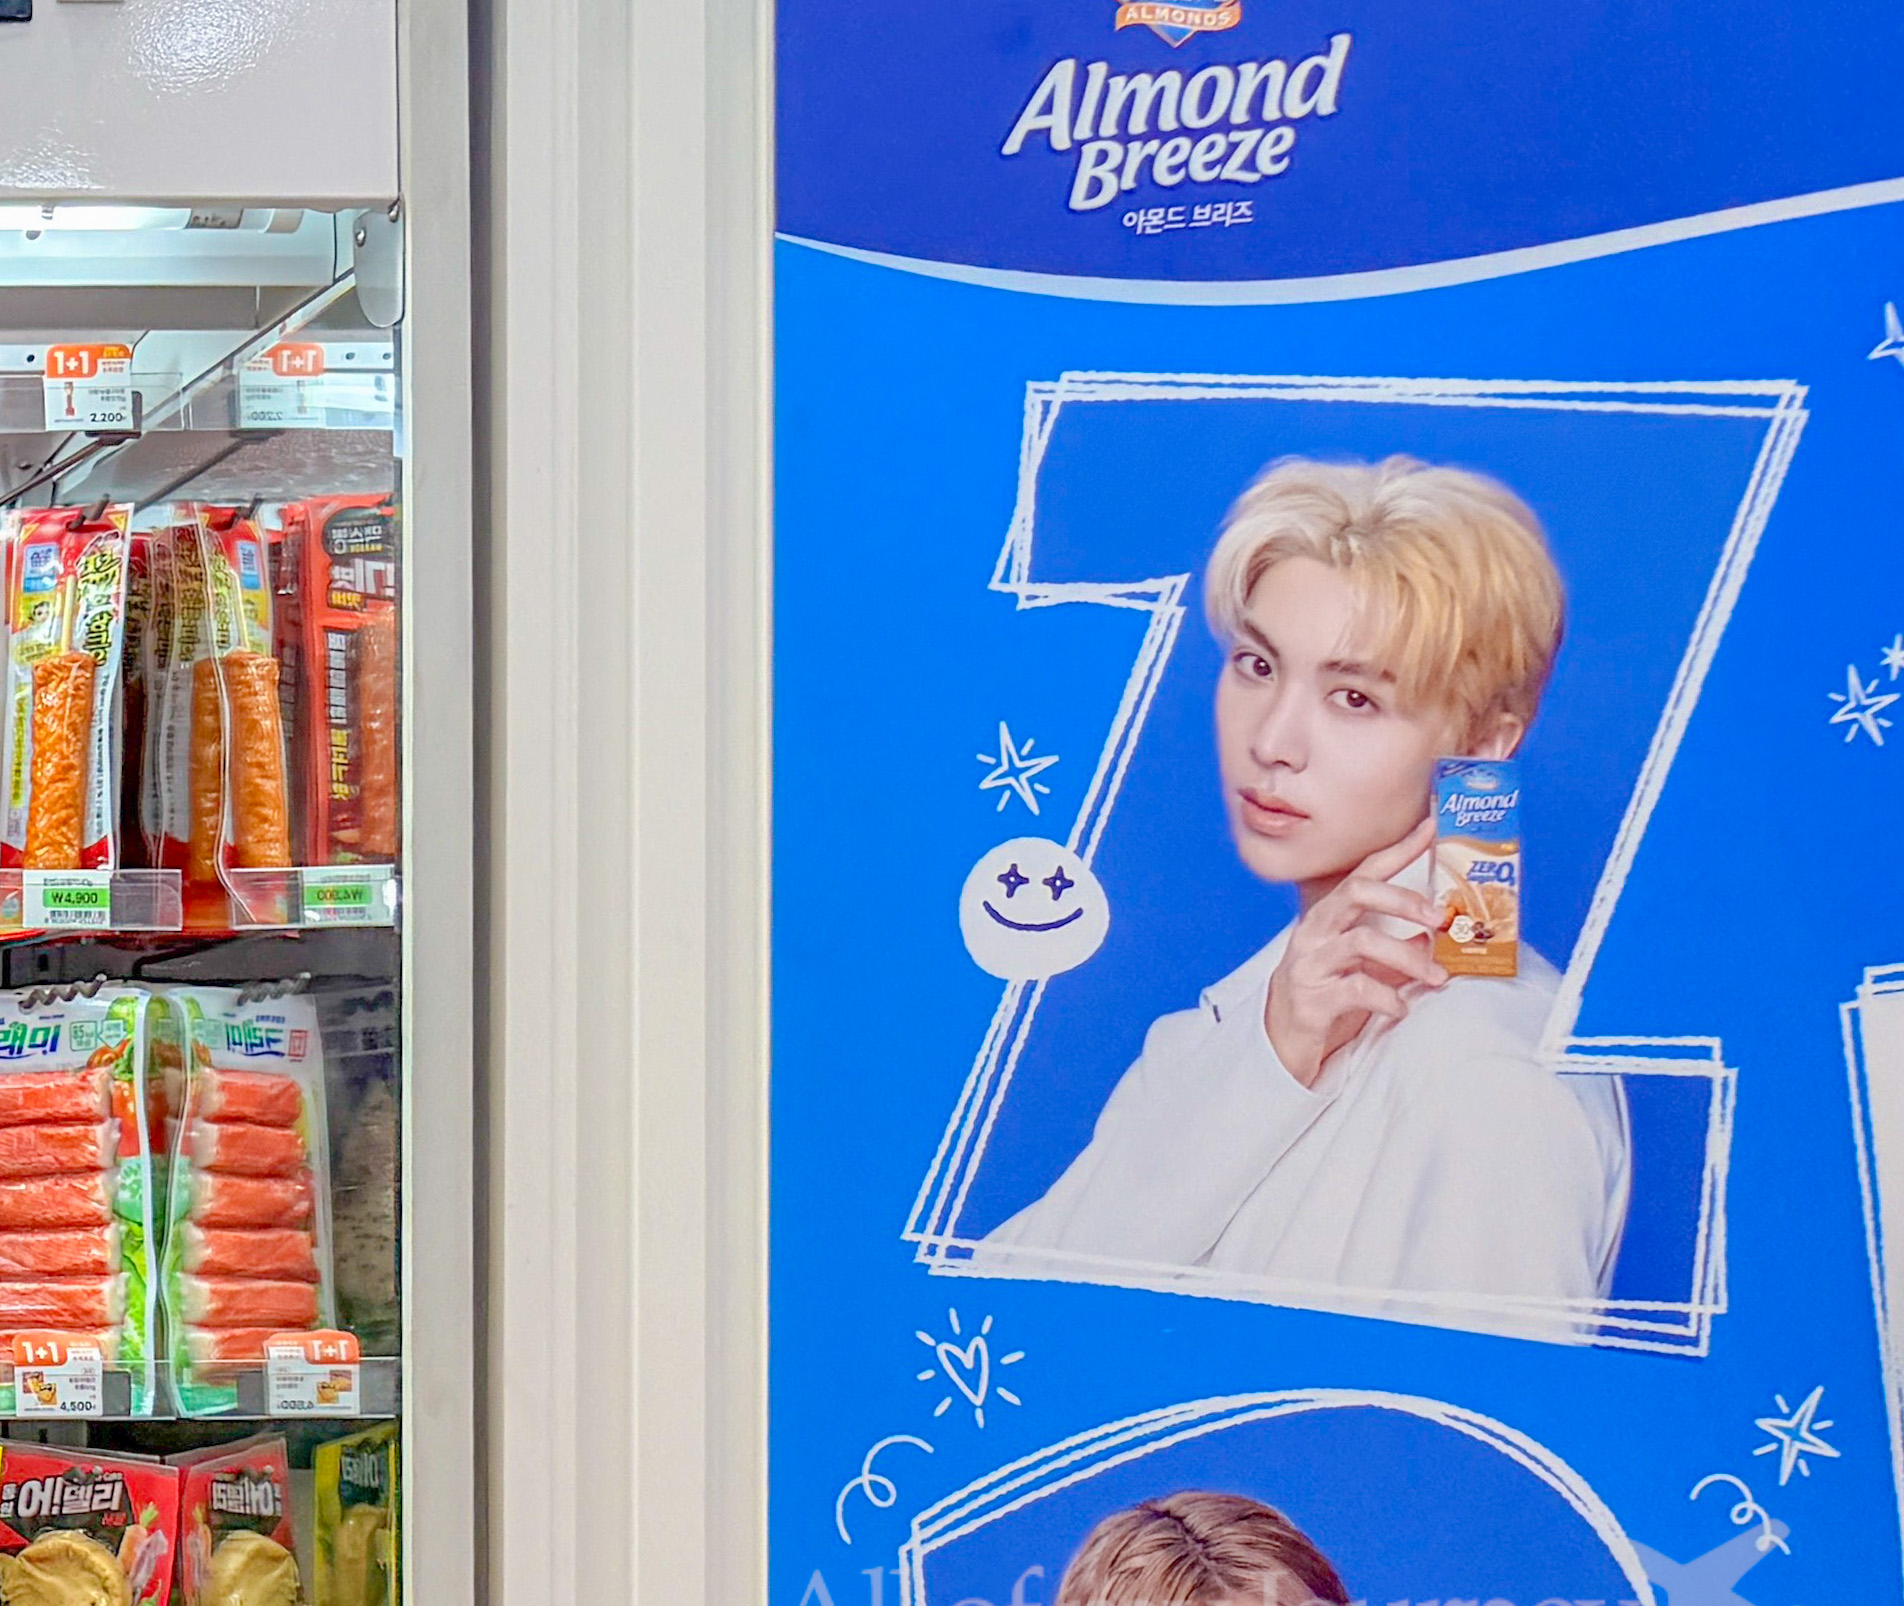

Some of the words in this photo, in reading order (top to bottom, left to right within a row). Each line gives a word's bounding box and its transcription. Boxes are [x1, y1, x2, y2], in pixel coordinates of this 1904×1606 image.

[1002, 34, 1351, 156] Almond
[1070, 124, 1295, 210] Breeze
[1123, 208, 1182, 235] 아몬드
[1190, 202, 1253, 229] 브리즈
[54, 352, 91, 374] 1+1
[1440, 790, 1519, 815] Almond
[1455, 809, 1505, 827] Breeze
[21, 1341, 59, 1363] 1+1
